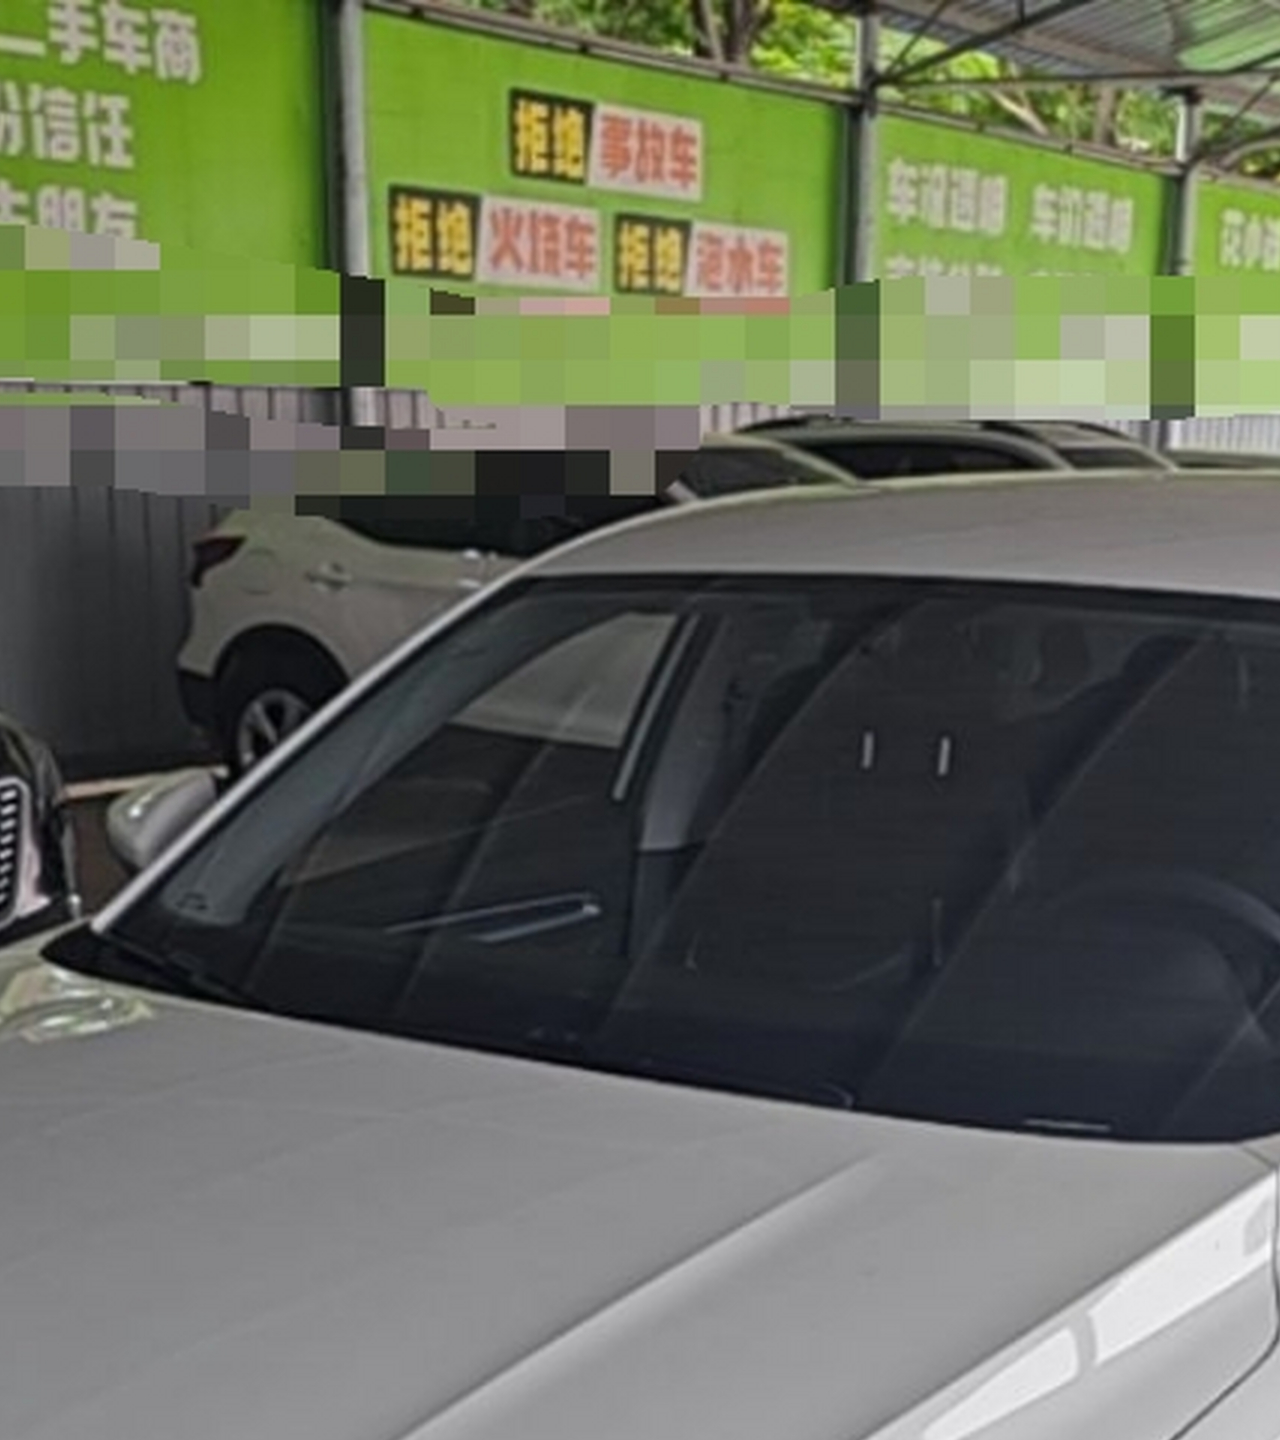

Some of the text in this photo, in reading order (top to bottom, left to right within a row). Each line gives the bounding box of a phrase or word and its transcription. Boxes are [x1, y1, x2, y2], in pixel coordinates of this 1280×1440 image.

[513, 97, 699, 189] 拒绝 事故车
[393, 193, 595, 278] 拒绝 火烧车
[618, 220, 683, 293] 拒绝
